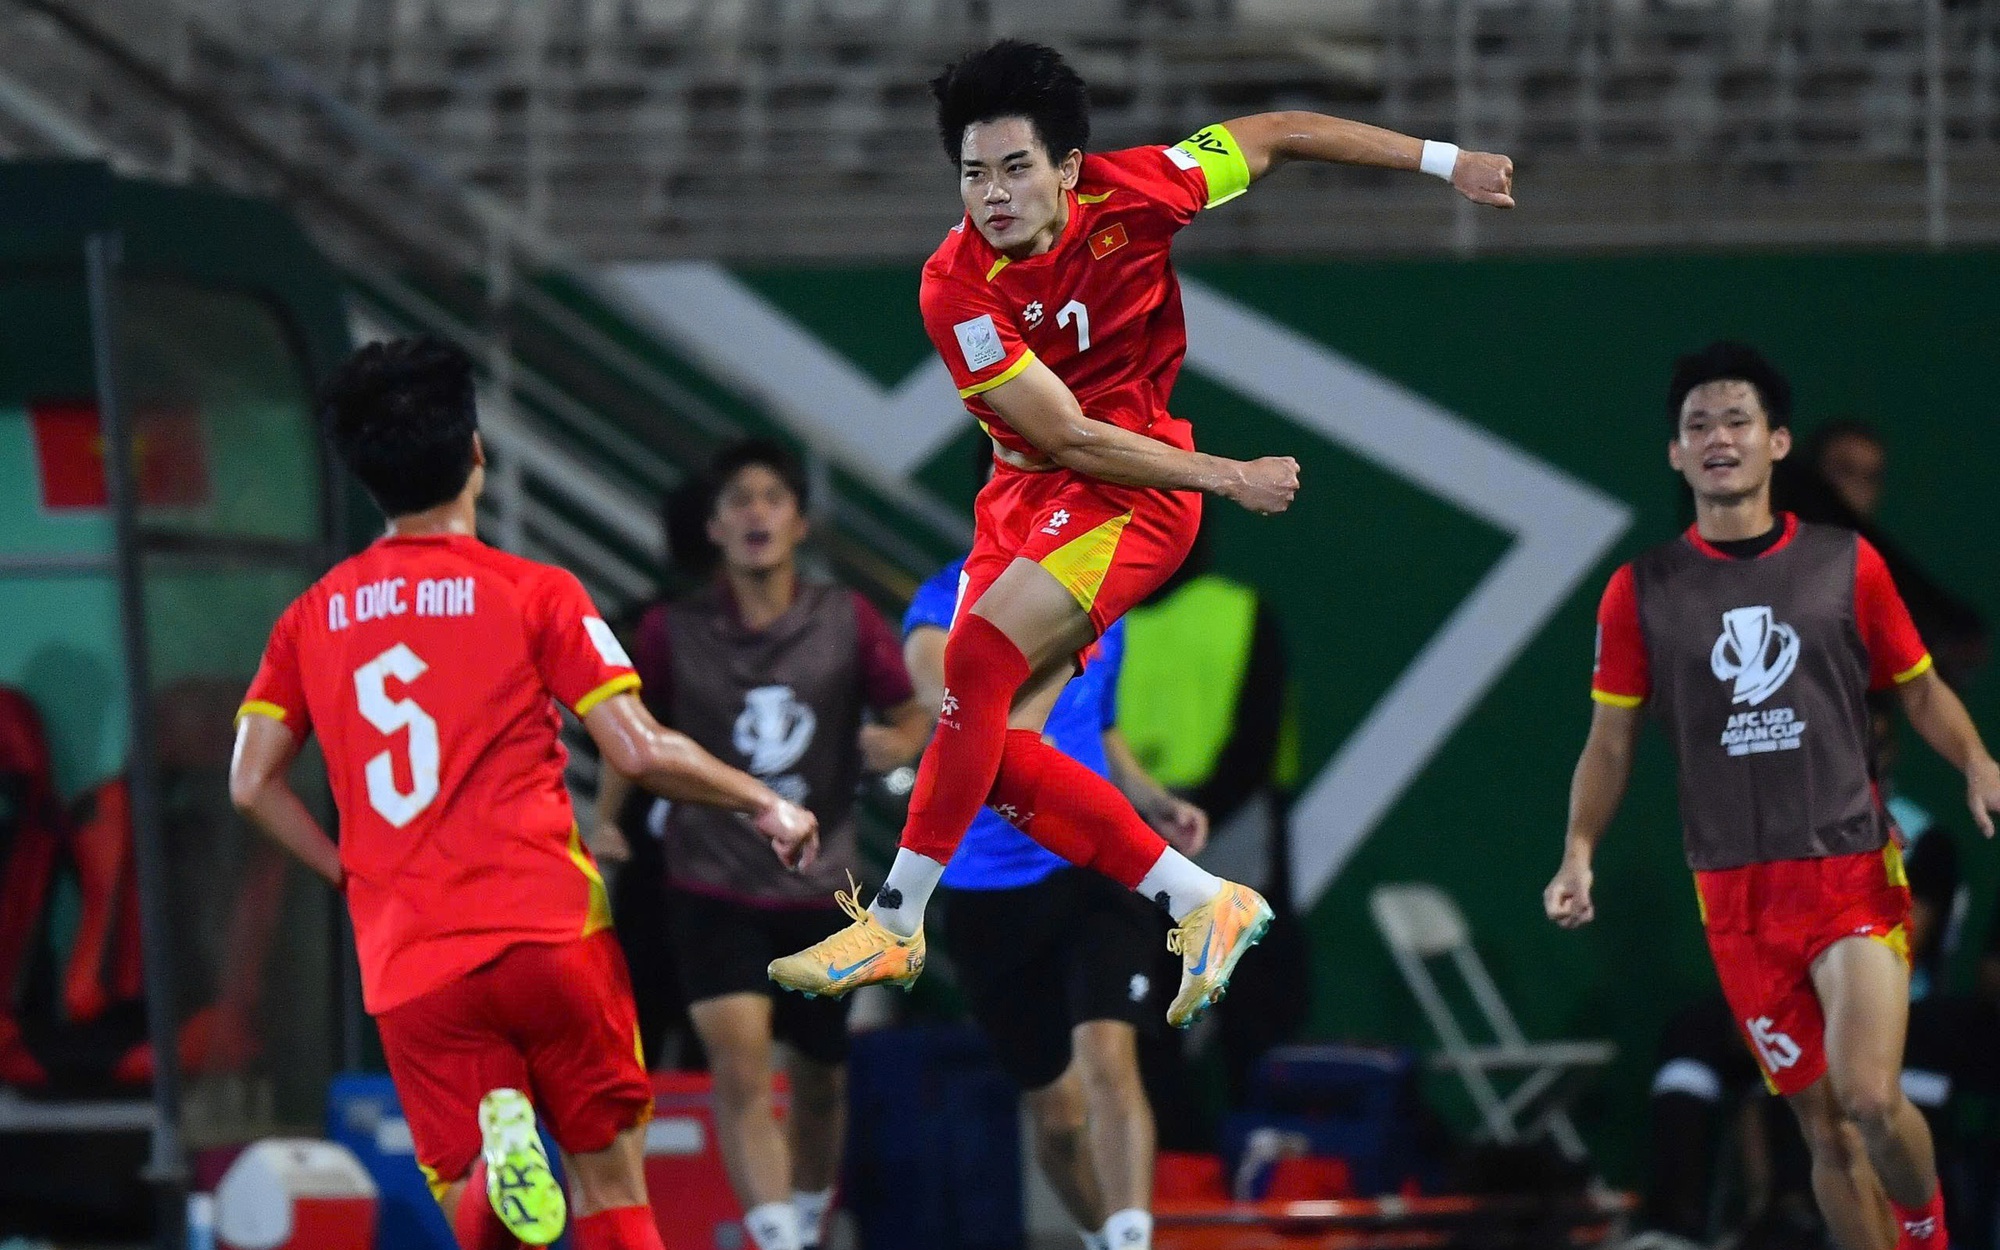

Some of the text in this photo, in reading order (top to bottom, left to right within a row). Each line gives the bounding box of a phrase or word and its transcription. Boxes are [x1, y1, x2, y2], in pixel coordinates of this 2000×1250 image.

[1055, 299, 1091, 353] 7
[353, 641, 440, 830] 5
[1727, 710, 1760, 730] AFC
[1745, 1015, 1802, 1075] 15
